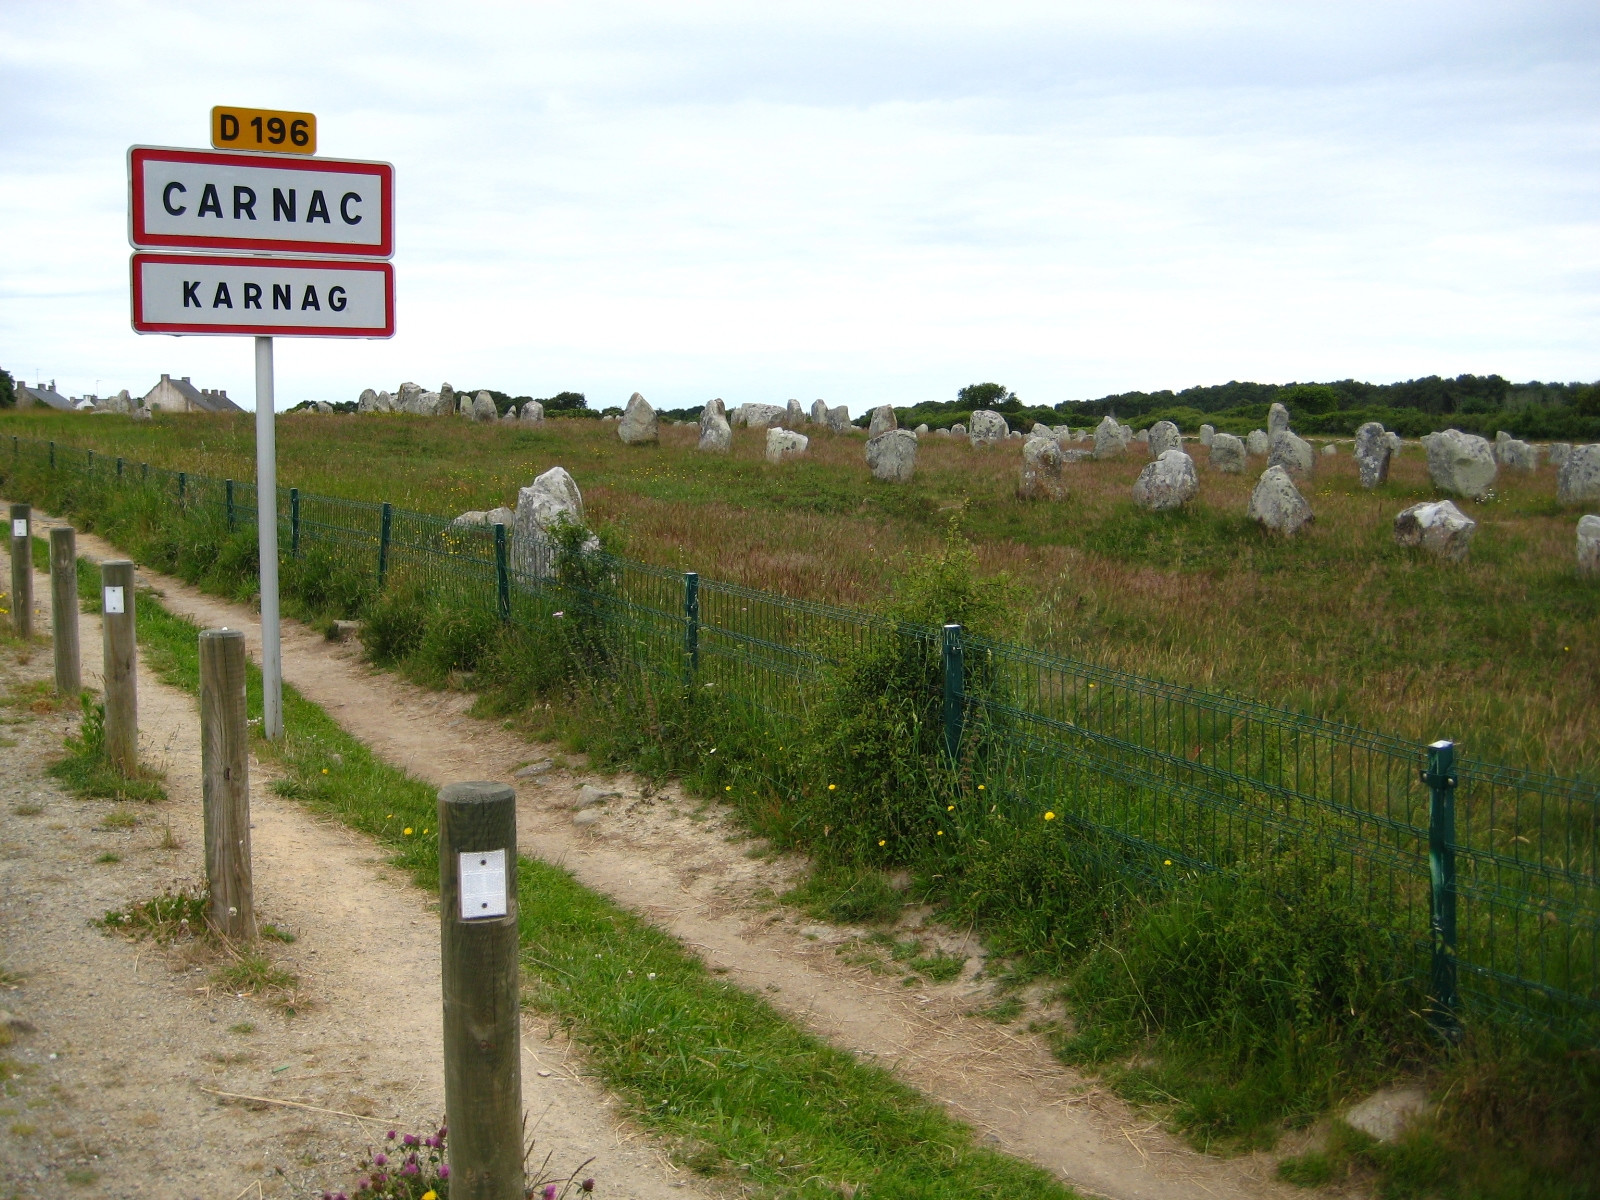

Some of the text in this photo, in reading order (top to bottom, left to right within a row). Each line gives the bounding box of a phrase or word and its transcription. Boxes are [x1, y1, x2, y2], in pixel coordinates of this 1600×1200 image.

[219, 113, 310, 147] D 196
[162, 181, 363, 226] CARNAC
[182, 280, 348, 312] KARNAG
